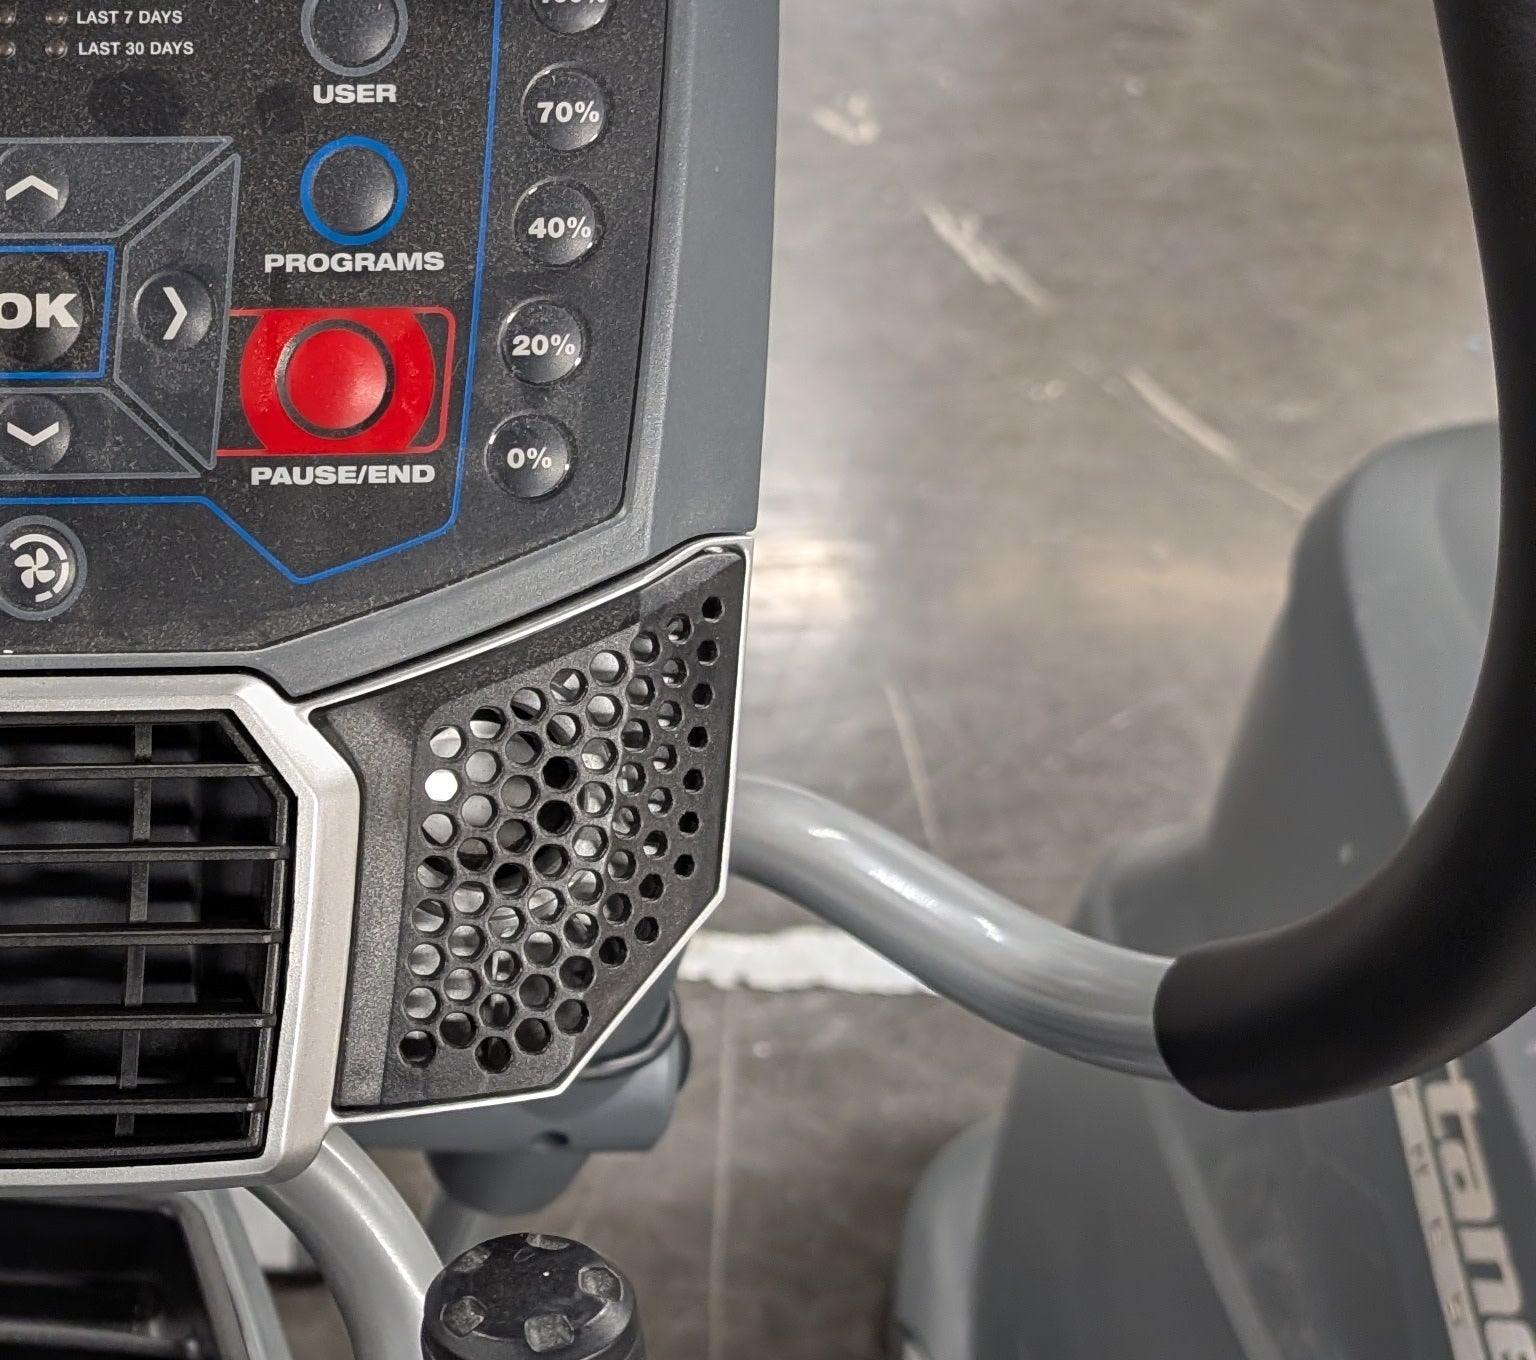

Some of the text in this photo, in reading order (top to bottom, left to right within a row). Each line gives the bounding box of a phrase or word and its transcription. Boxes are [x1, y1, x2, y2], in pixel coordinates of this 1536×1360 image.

[76, 10, 183, 25] LAST 7 DAYS
[78, 41, 194, 56] LAST 30 DAYS
[313, 83, 397, 104] USER
[536, 101, 600, 124] 70%
[527, 216, 592, 239] 40%
[264, 251, 445, 273] PROGRAMS
[511, 333, 579, 359] 20%
[506, 446, 555, 472] 0%
[251, 464, 436, 486] PAUSE/END
